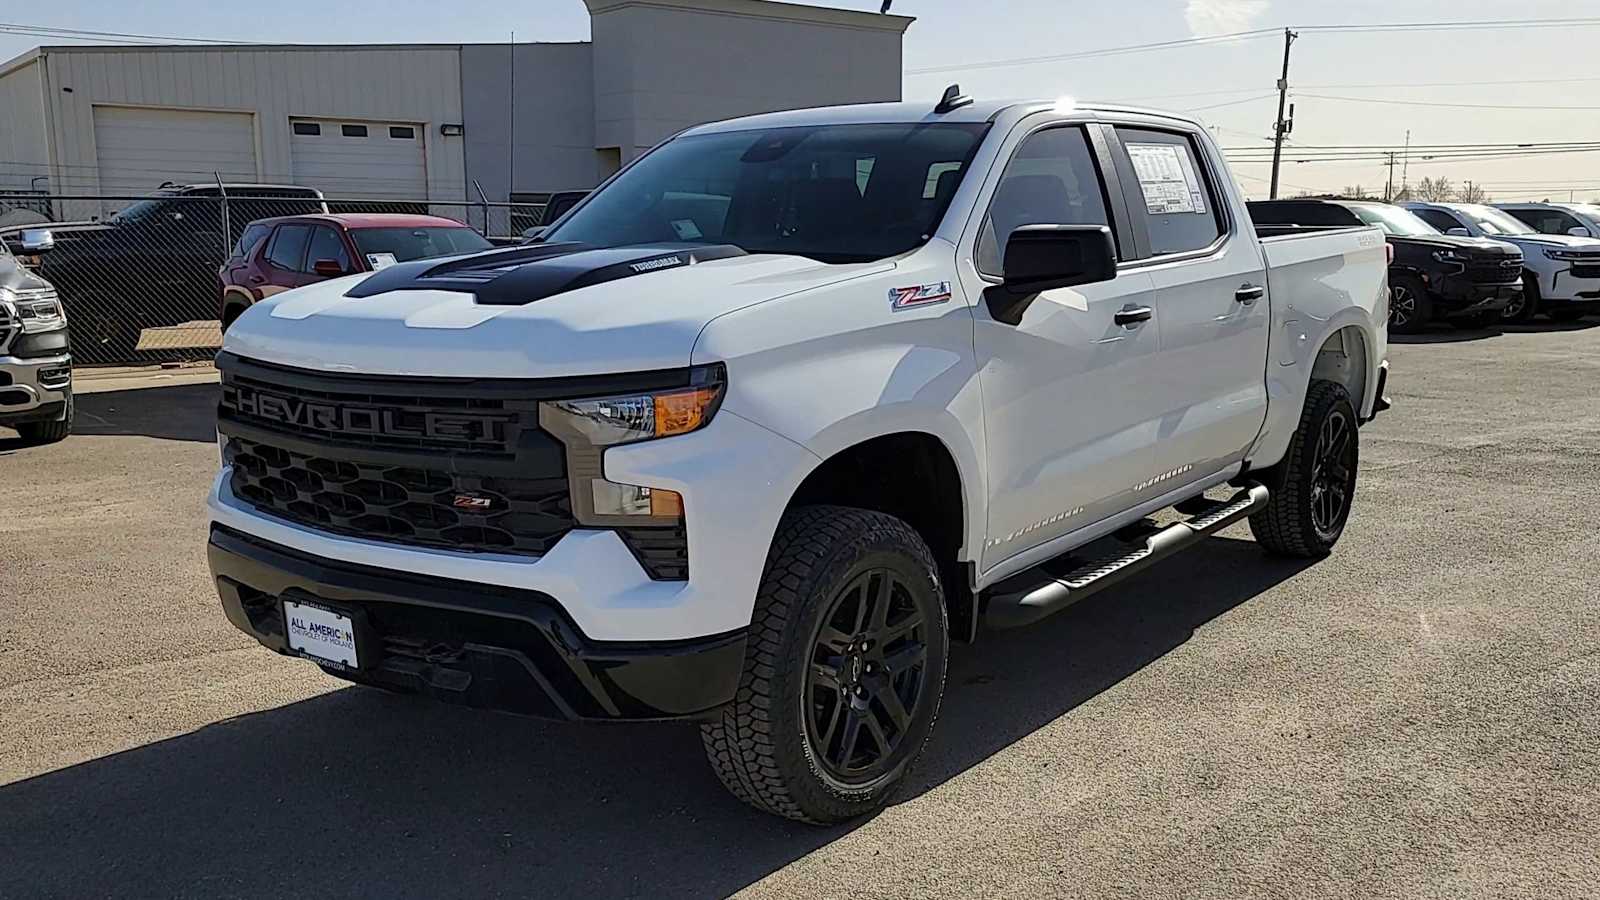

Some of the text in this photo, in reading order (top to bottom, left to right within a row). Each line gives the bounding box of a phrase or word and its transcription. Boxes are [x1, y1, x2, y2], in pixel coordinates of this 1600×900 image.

[630, 256, 682, 271] TURBOMAX
[888, 281, 952, 313] Z71
[221, 386, 510, 442] CHEVROLET
[453, 495, 491, 508] Z71
[291, 617, 306, 630] ALL
